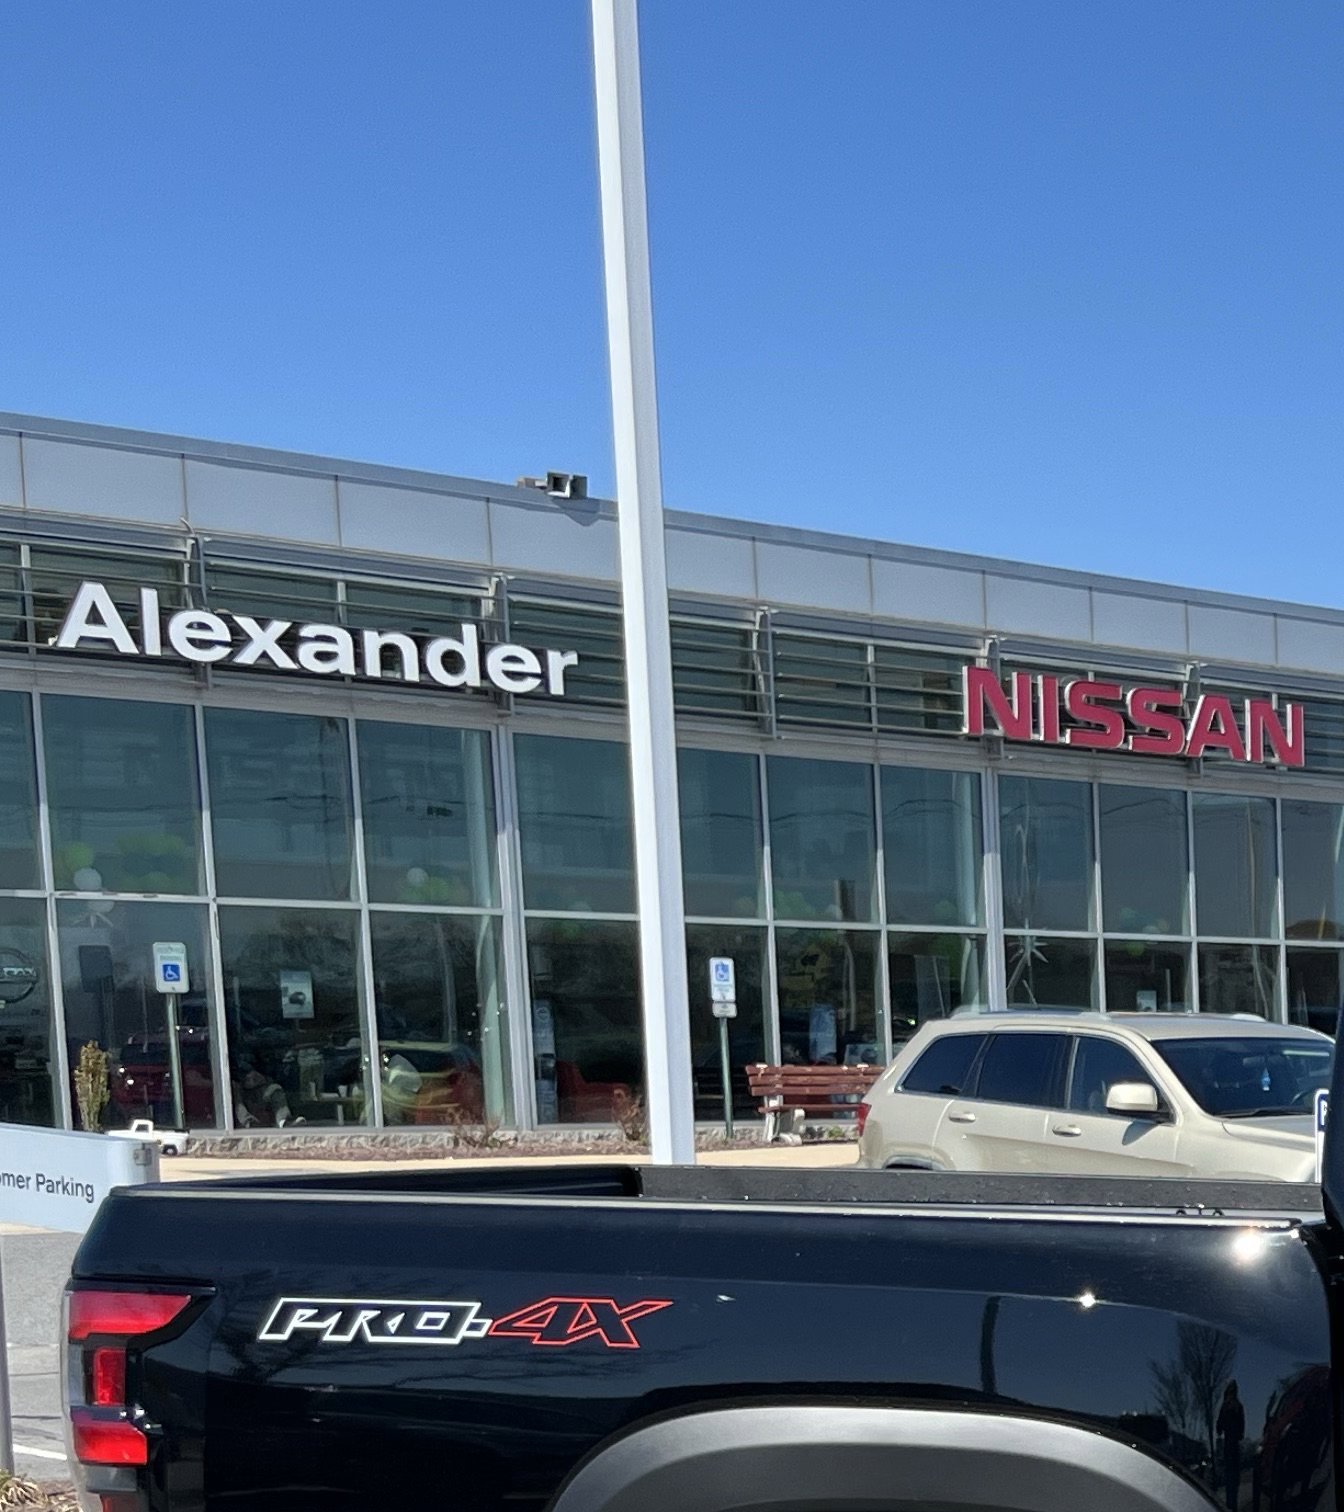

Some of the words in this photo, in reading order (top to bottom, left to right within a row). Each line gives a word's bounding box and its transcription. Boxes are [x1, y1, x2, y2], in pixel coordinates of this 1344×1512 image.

[54, 581, 579, 695] Alexander
[962, 666, 1304, 767] NISSAN
[0, 1172, 31, 1190] mer
[36, 1173, 94, 1204] Parking
